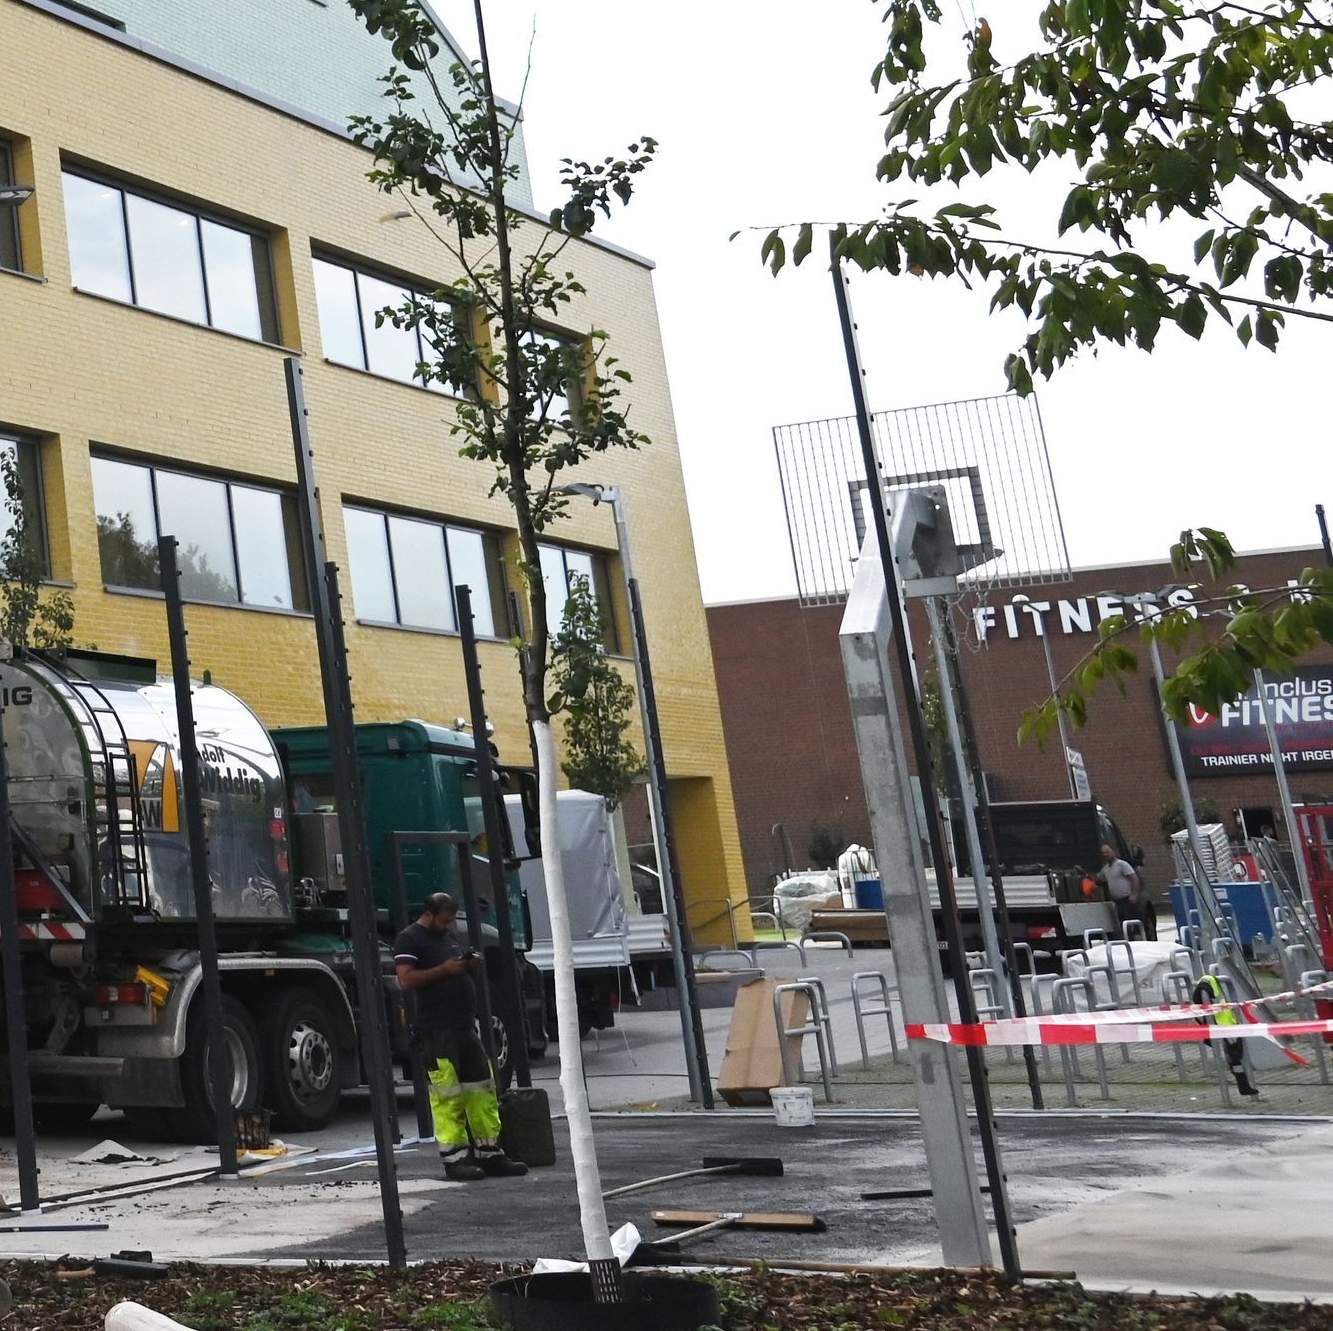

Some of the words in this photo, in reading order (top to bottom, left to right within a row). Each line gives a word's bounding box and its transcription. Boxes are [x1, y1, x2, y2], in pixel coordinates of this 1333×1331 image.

[1258, 677, 1332, 700] nclus
[1201, 753, 1258, 767] TRAINIER
[1260, 751, 1299, 764] NIHT
[1301, 749, 1333, 762] IRGE
